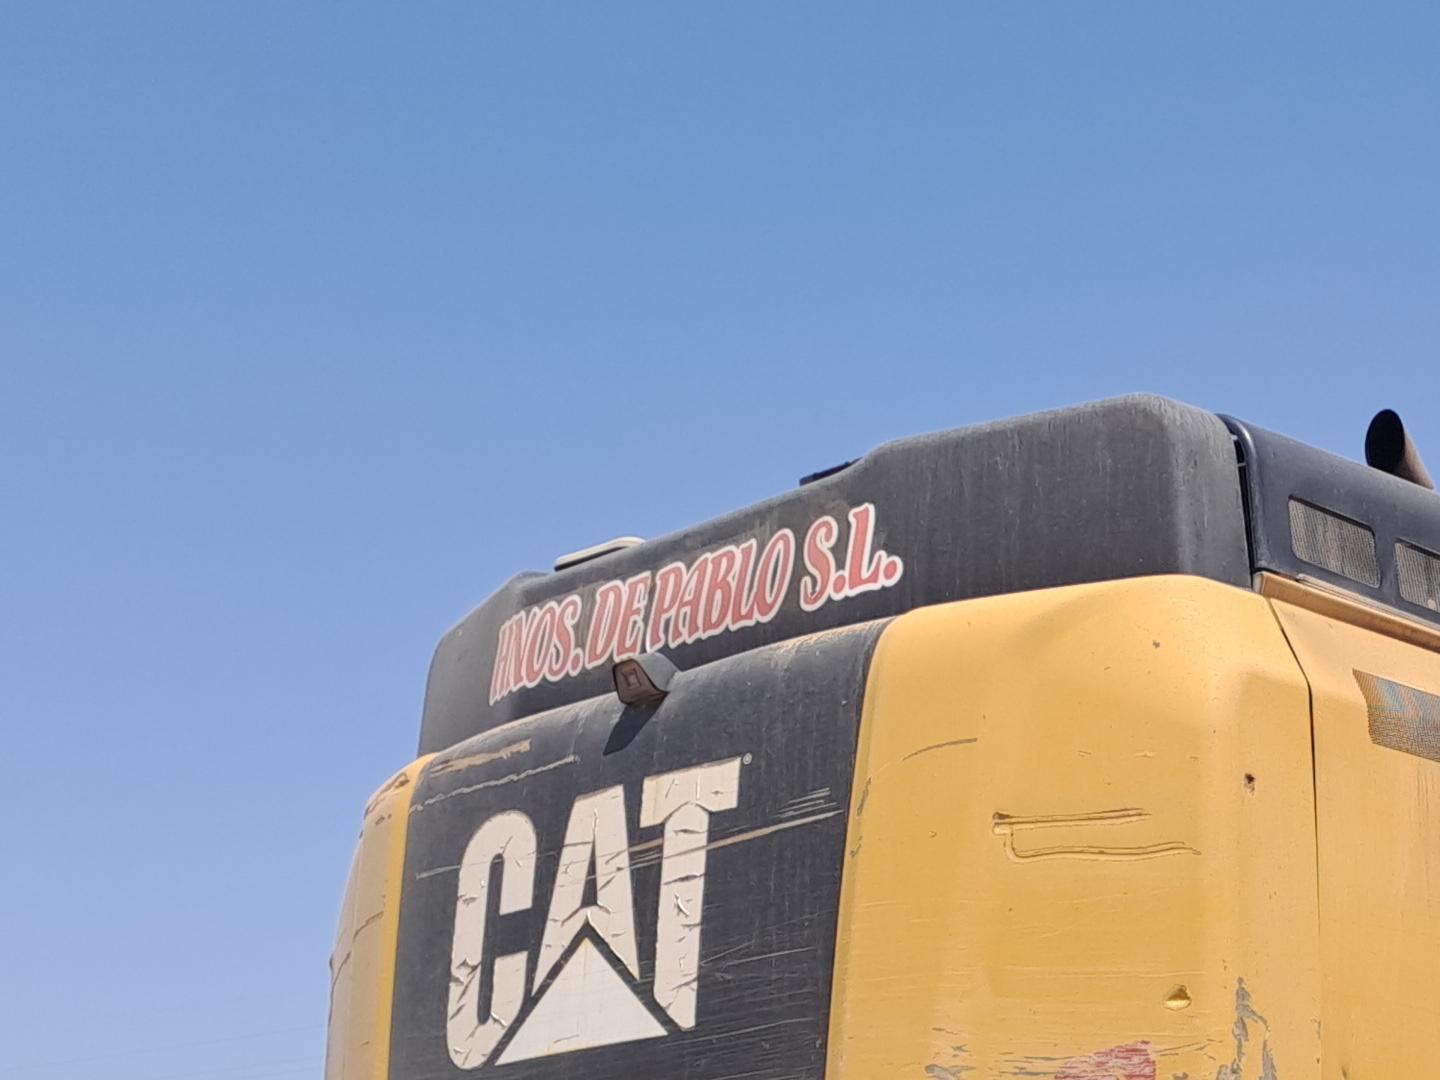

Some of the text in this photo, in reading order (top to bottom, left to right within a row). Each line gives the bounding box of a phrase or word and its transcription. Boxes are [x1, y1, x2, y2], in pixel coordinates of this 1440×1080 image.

[586, 570, 652, 668] DE
[645, 528, 795, 652] PABLO
[800, 502, 903, 612] S.L.
[446, 757, 742, 1070] CAT
